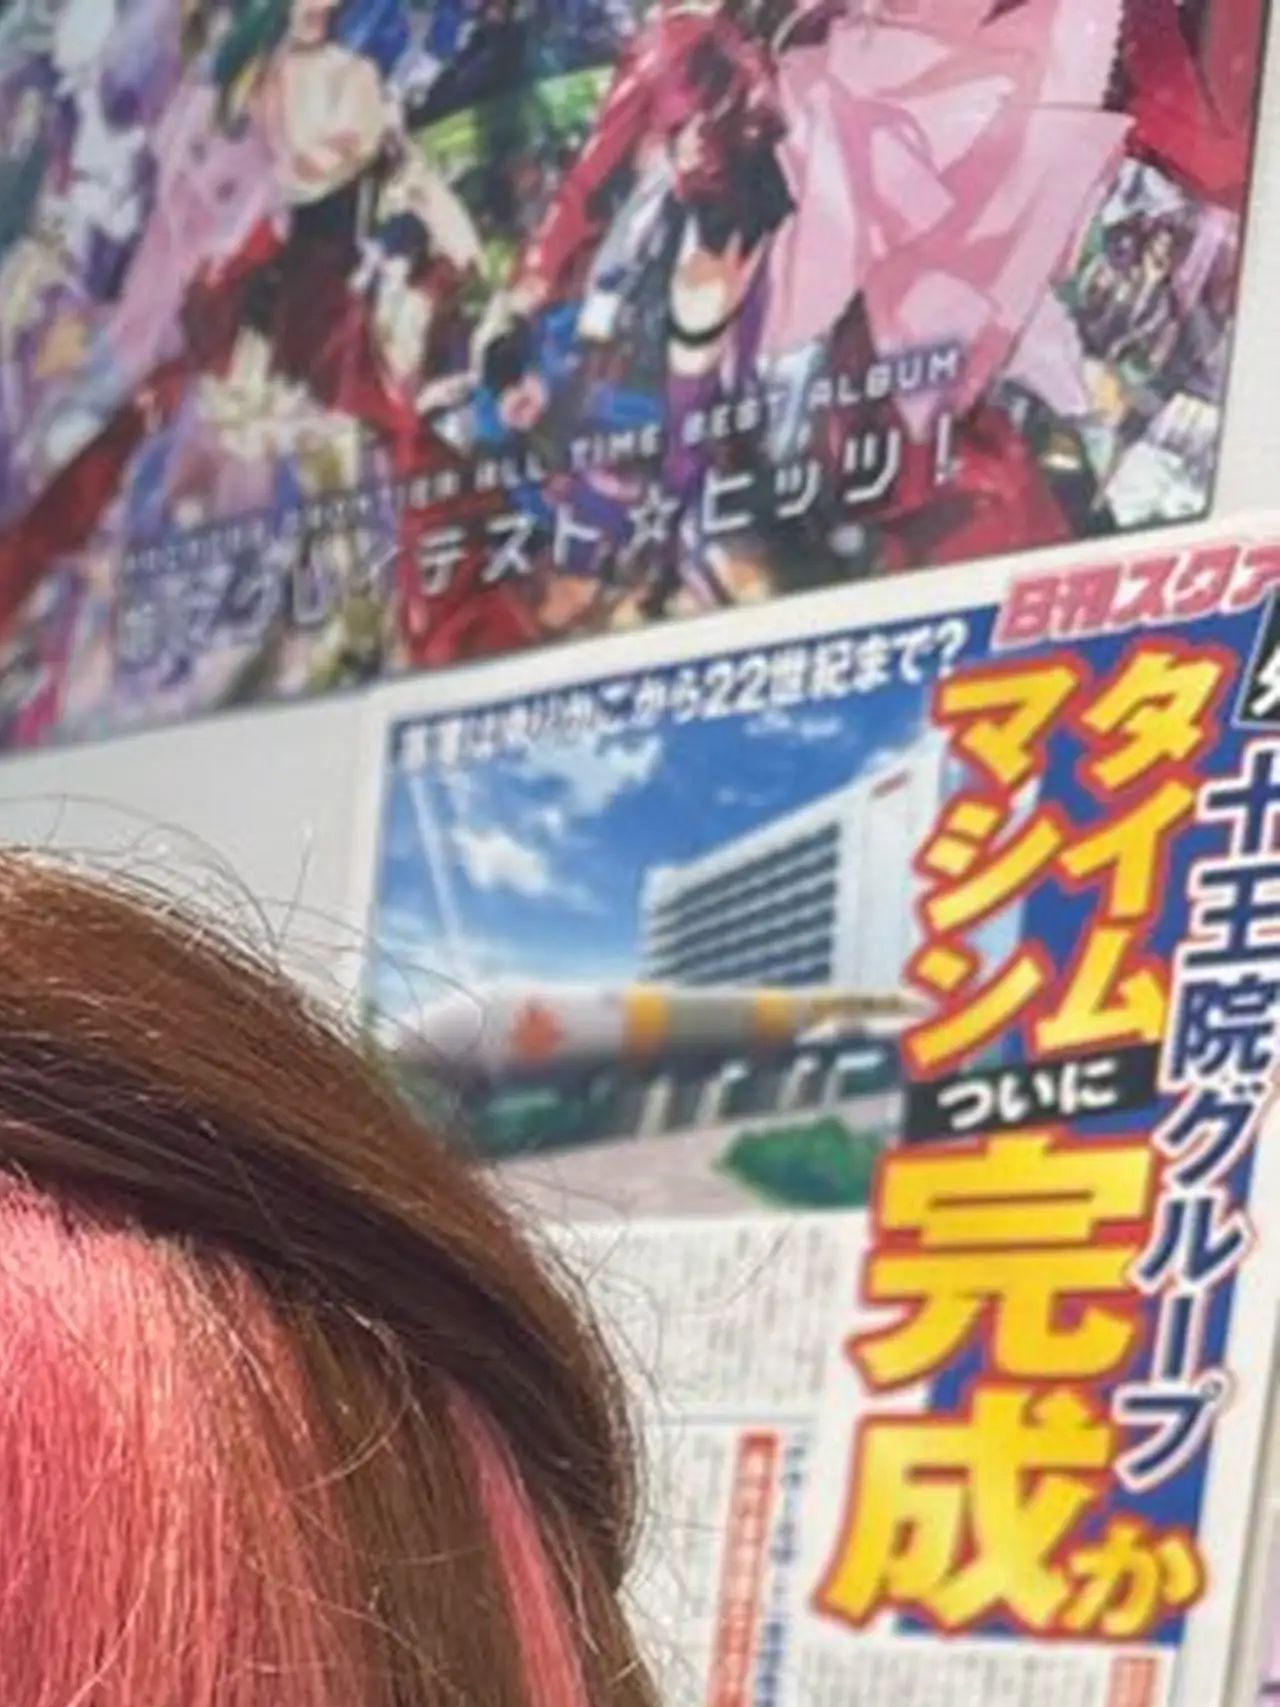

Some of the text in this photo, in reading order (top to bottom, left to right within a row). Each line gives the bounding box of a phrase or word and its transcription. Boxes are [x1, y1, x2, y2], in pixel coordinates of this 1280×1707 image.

[571, 428, 661, 467] TIME
[810, 350, 960, 408] ALBUM
[904, 660, 1082, 1072] マシン
[1034, 645, 1226, 1054] タイム
[937, 1057, 1119, 1130] ついに
[820, 1132, 1202, 1636] 完成か
